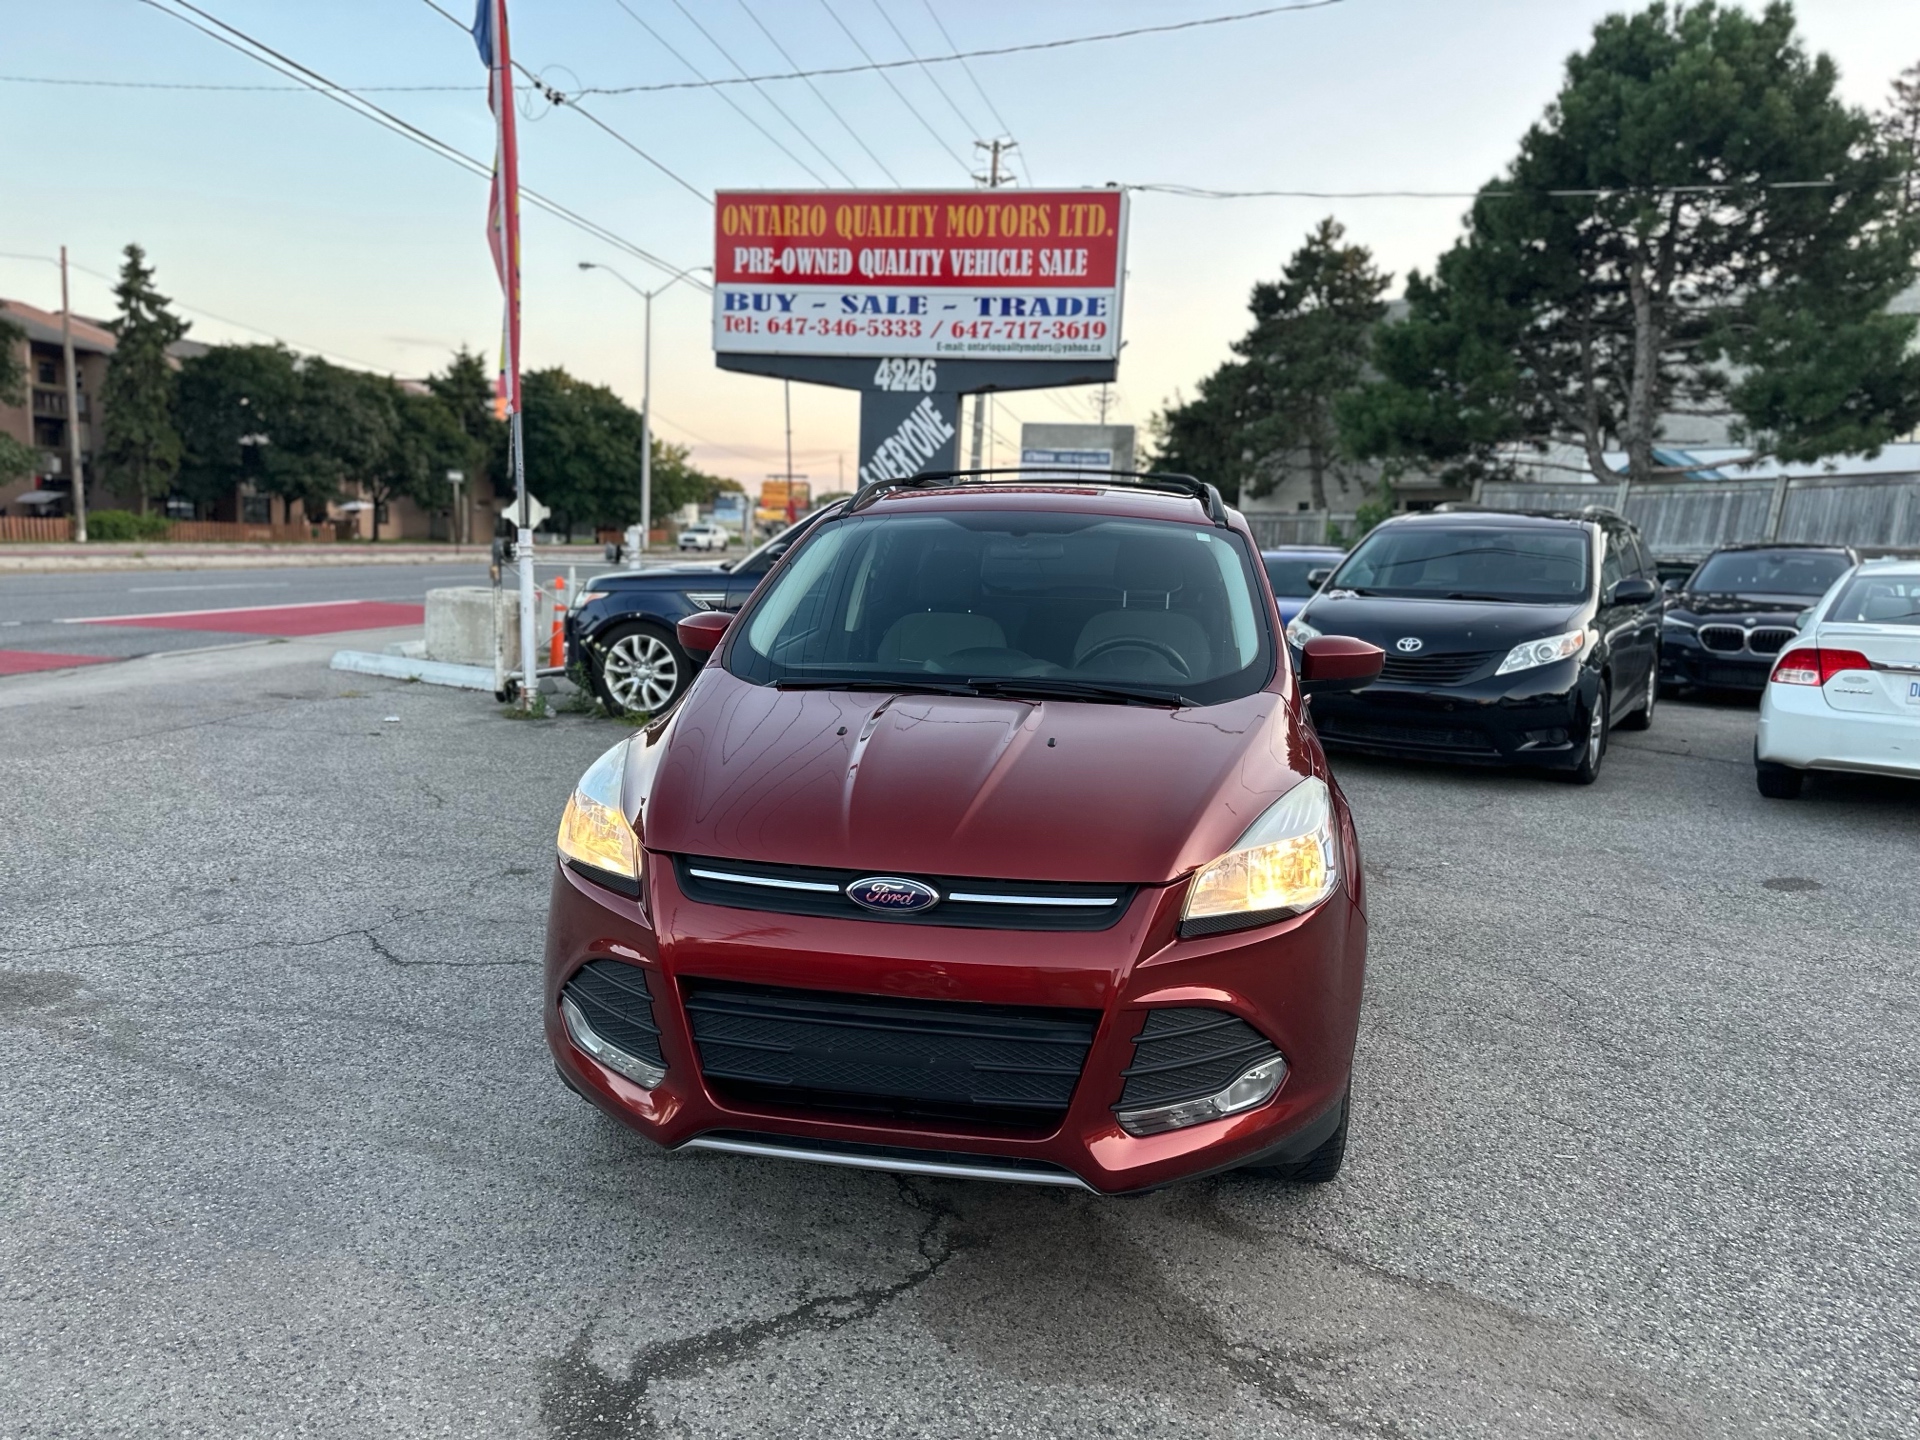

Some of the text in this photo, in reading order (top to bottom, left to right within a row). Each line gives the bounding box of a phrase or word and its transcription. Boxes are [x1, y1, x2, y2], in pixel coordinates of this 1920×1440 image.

[721, 204, 1114, 241] ONTARIO QUALITY MOTORS LTD.
[733, 247, 1088, 279] PRE-OWNED QUALITY VEHICLE SALE
[723, 293, 798, 313] BUY
[840, 294, 928, 316] SALE
[973, 296, 1107, 317] TRADE
[723, 314, 1107, 340] Tel: 647-346-5333 / 647-717-3619
[873, 357, 938, 393] 4226
[866, 882, 916, 905] Ford
